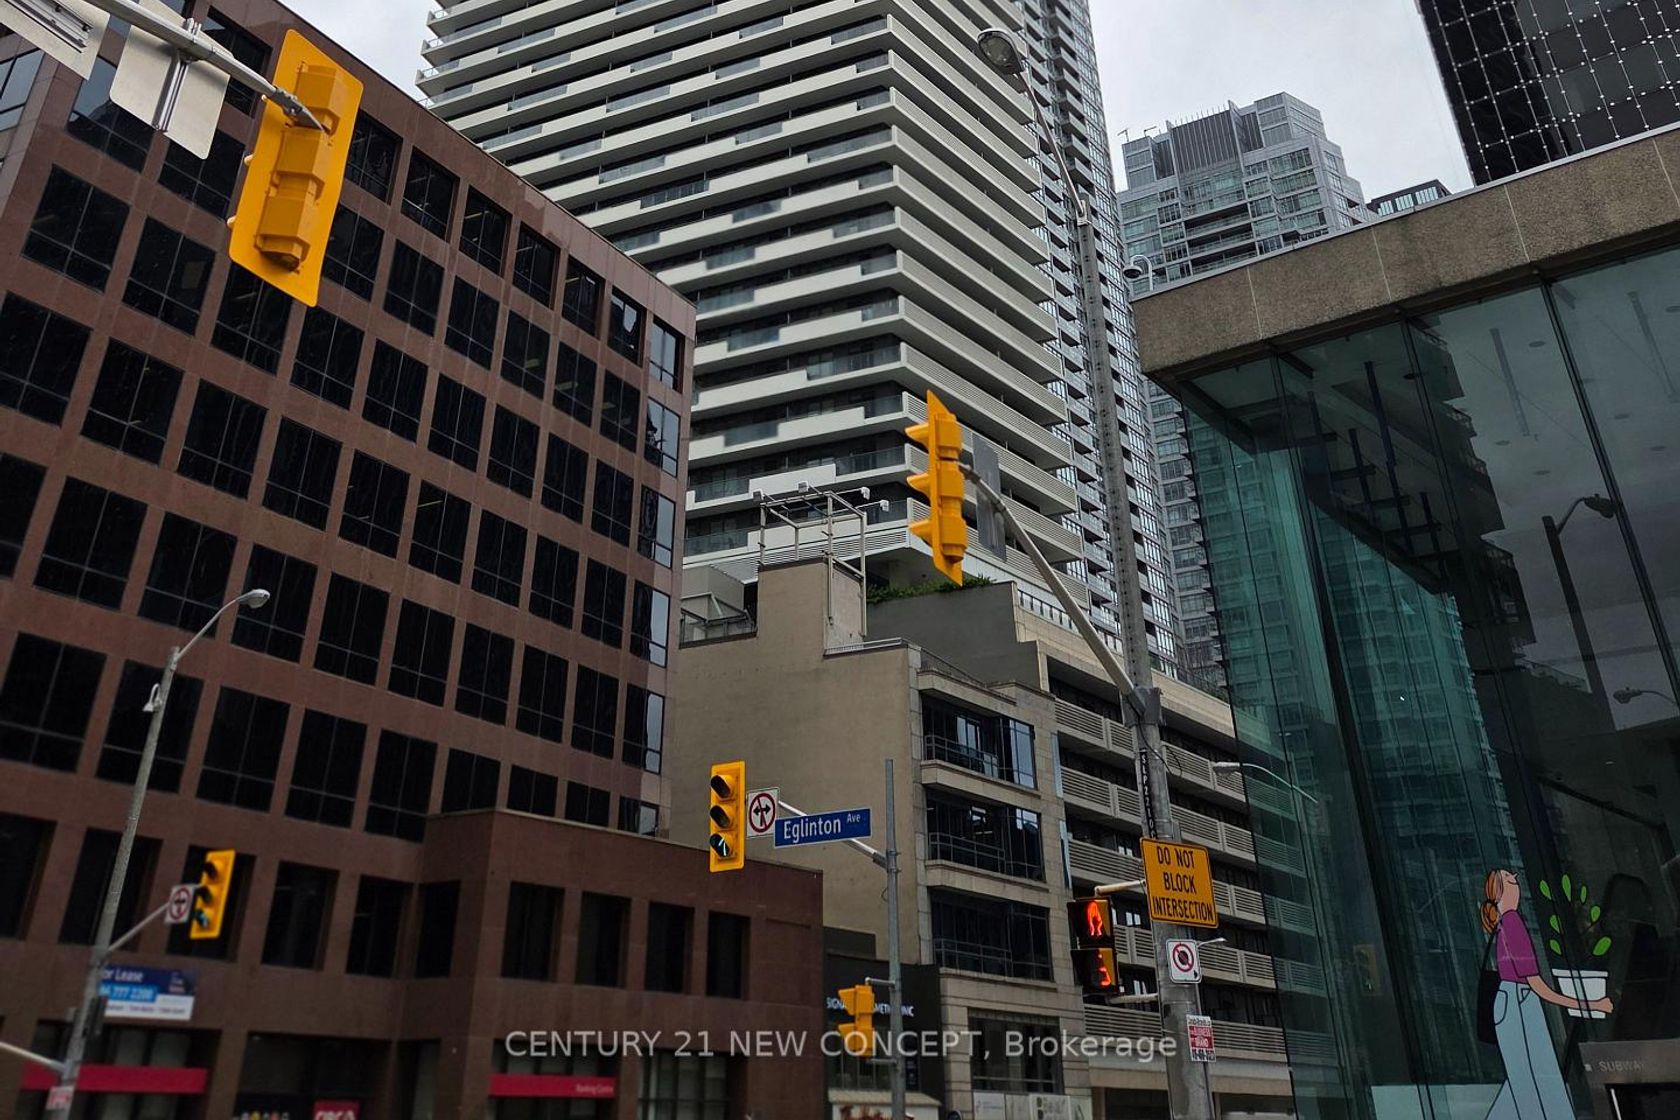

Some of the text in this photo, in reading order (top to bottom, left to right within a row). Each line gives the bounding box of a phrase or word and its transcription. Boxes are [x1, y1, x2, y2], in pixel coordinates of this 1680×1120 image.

[784, 813, 861, 843] Eglinton Ave
[1156, 845, 1195, 869] DO NOT
[1163, 871, 1197, 894] BLOCK
[1152, 896, 1214, 922] INTERSECTION
